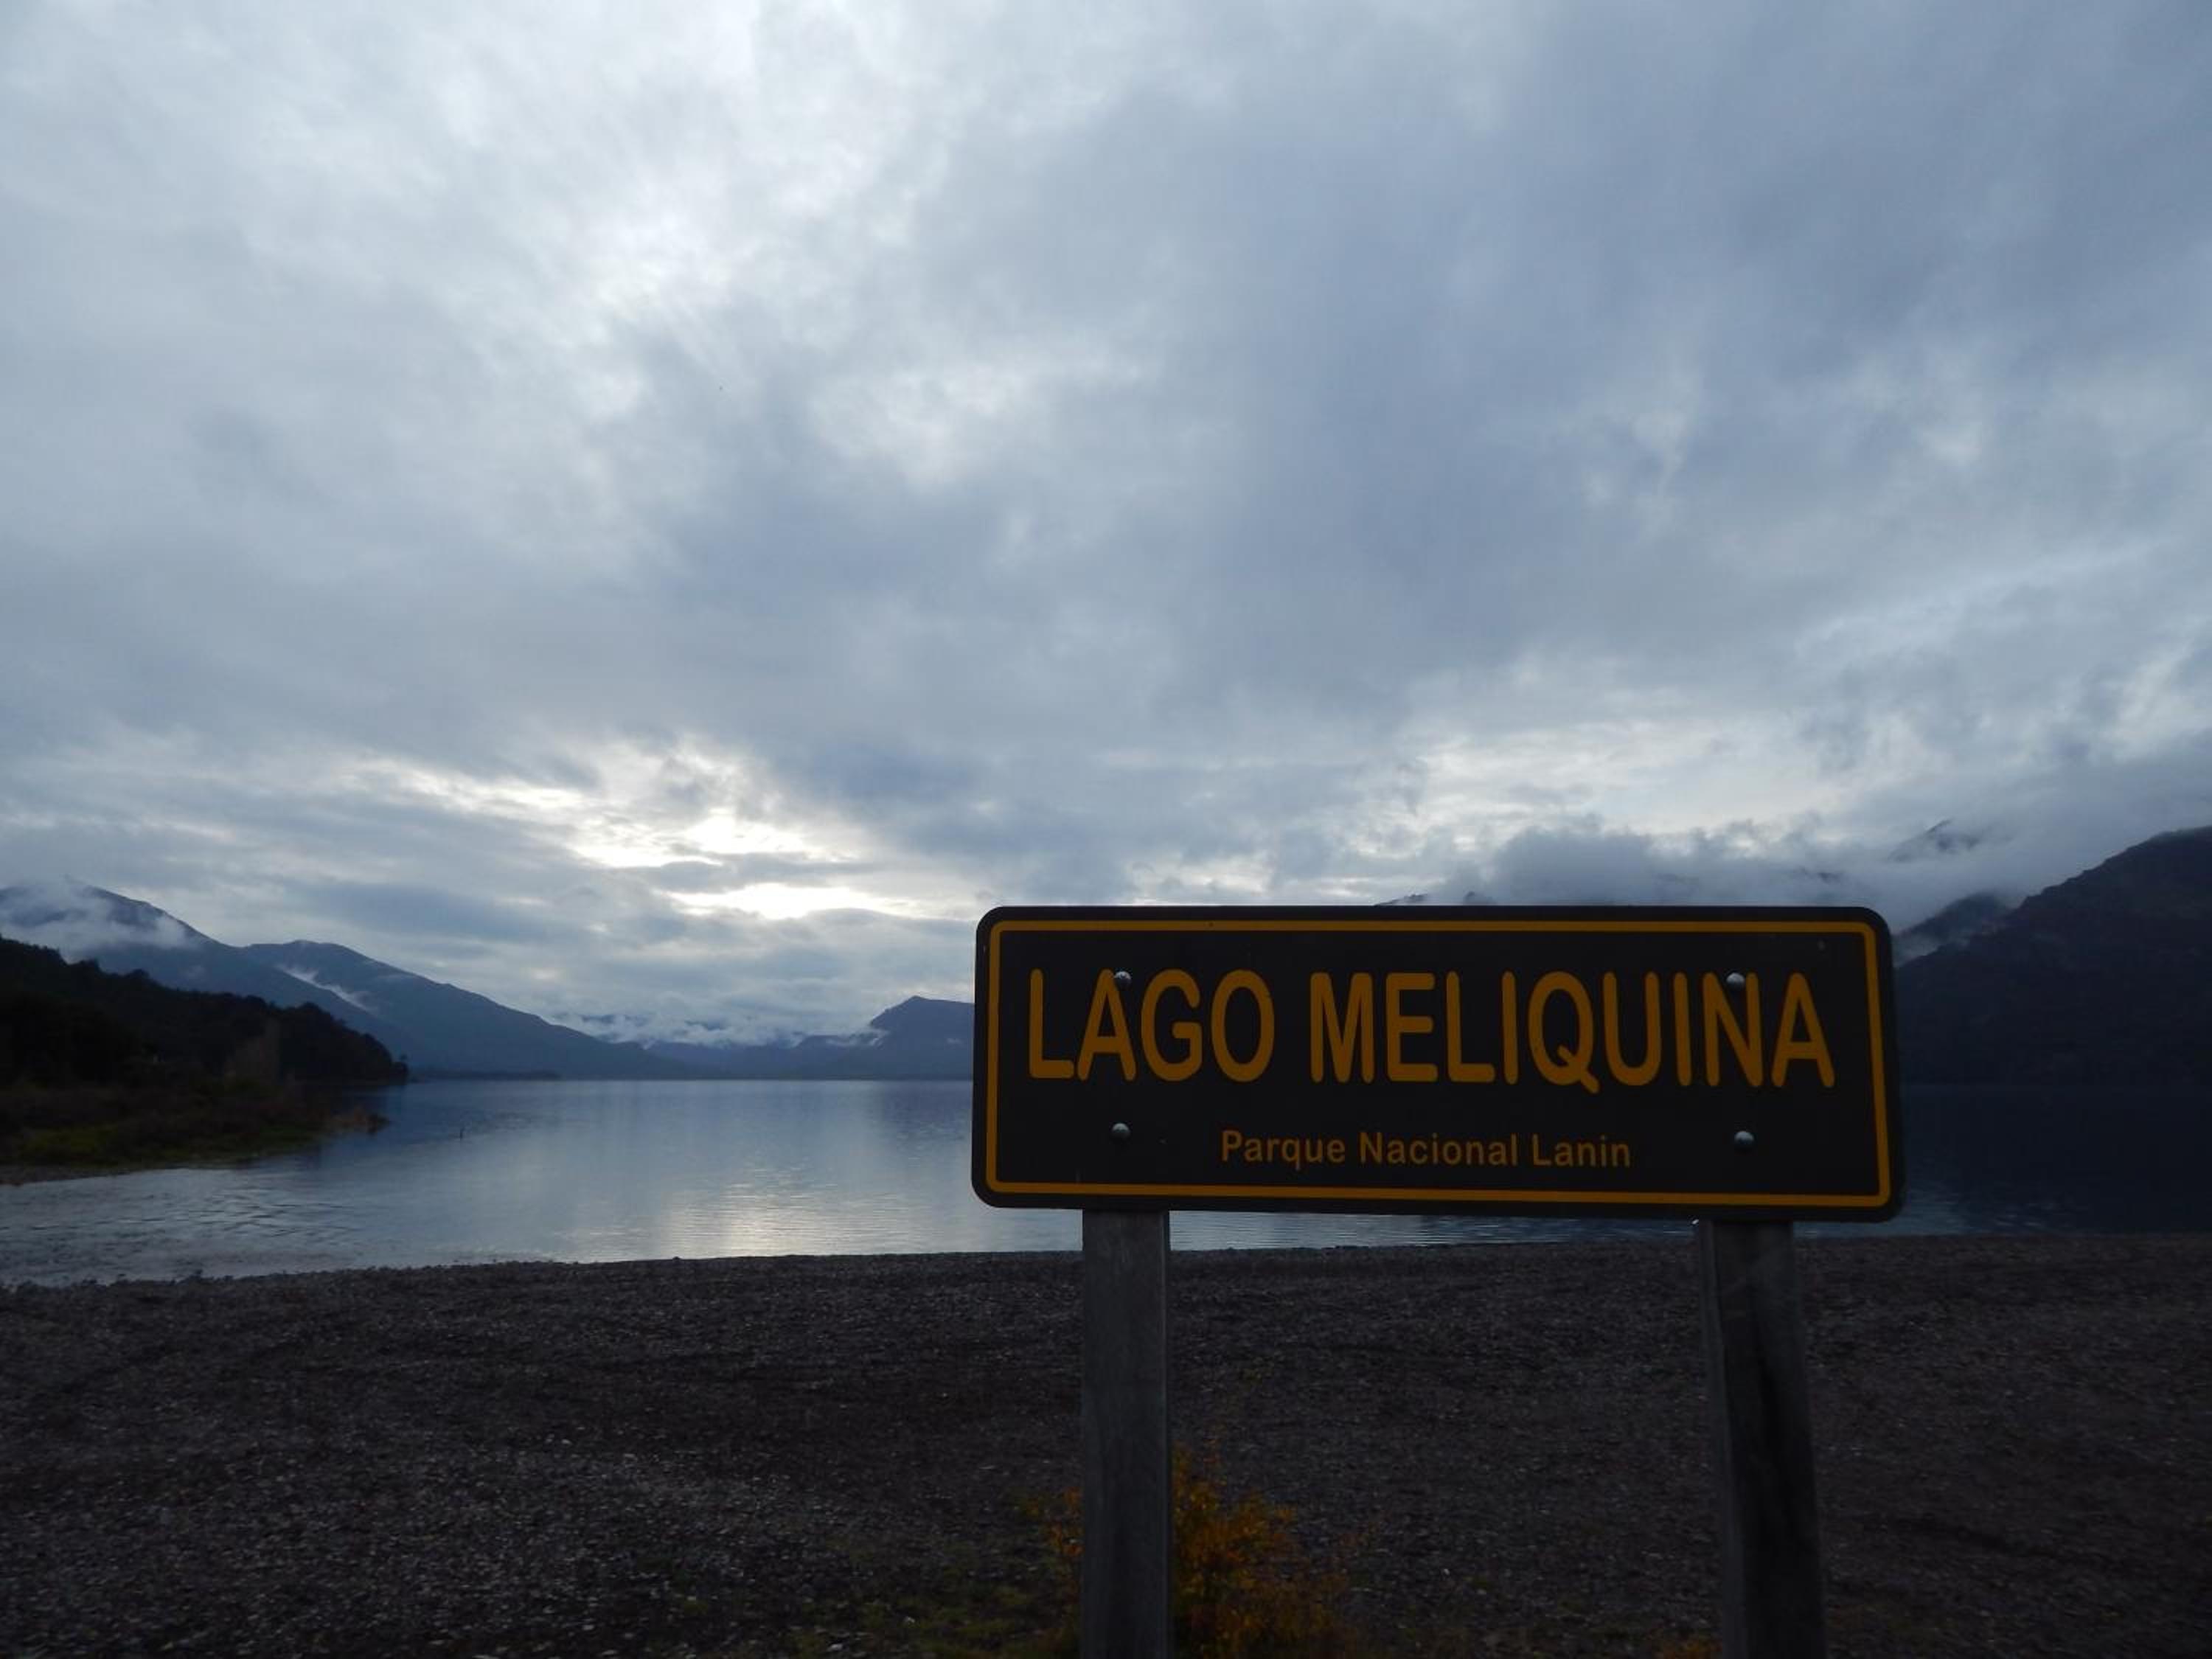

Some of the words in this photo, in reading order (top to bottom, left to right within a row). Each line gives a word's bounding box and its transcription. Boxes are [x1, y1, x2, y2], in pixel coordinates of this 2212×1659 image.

[1028, 967, 1275, 1082] LAGO
[1310, 970, 1836, 1093] MELIQUINA
[1220, 1129, 1346, 1170] Parque
[1358, 1131, 1518, 1167] Nacional
[1531, 1134, 1632, 1168] Lanin
